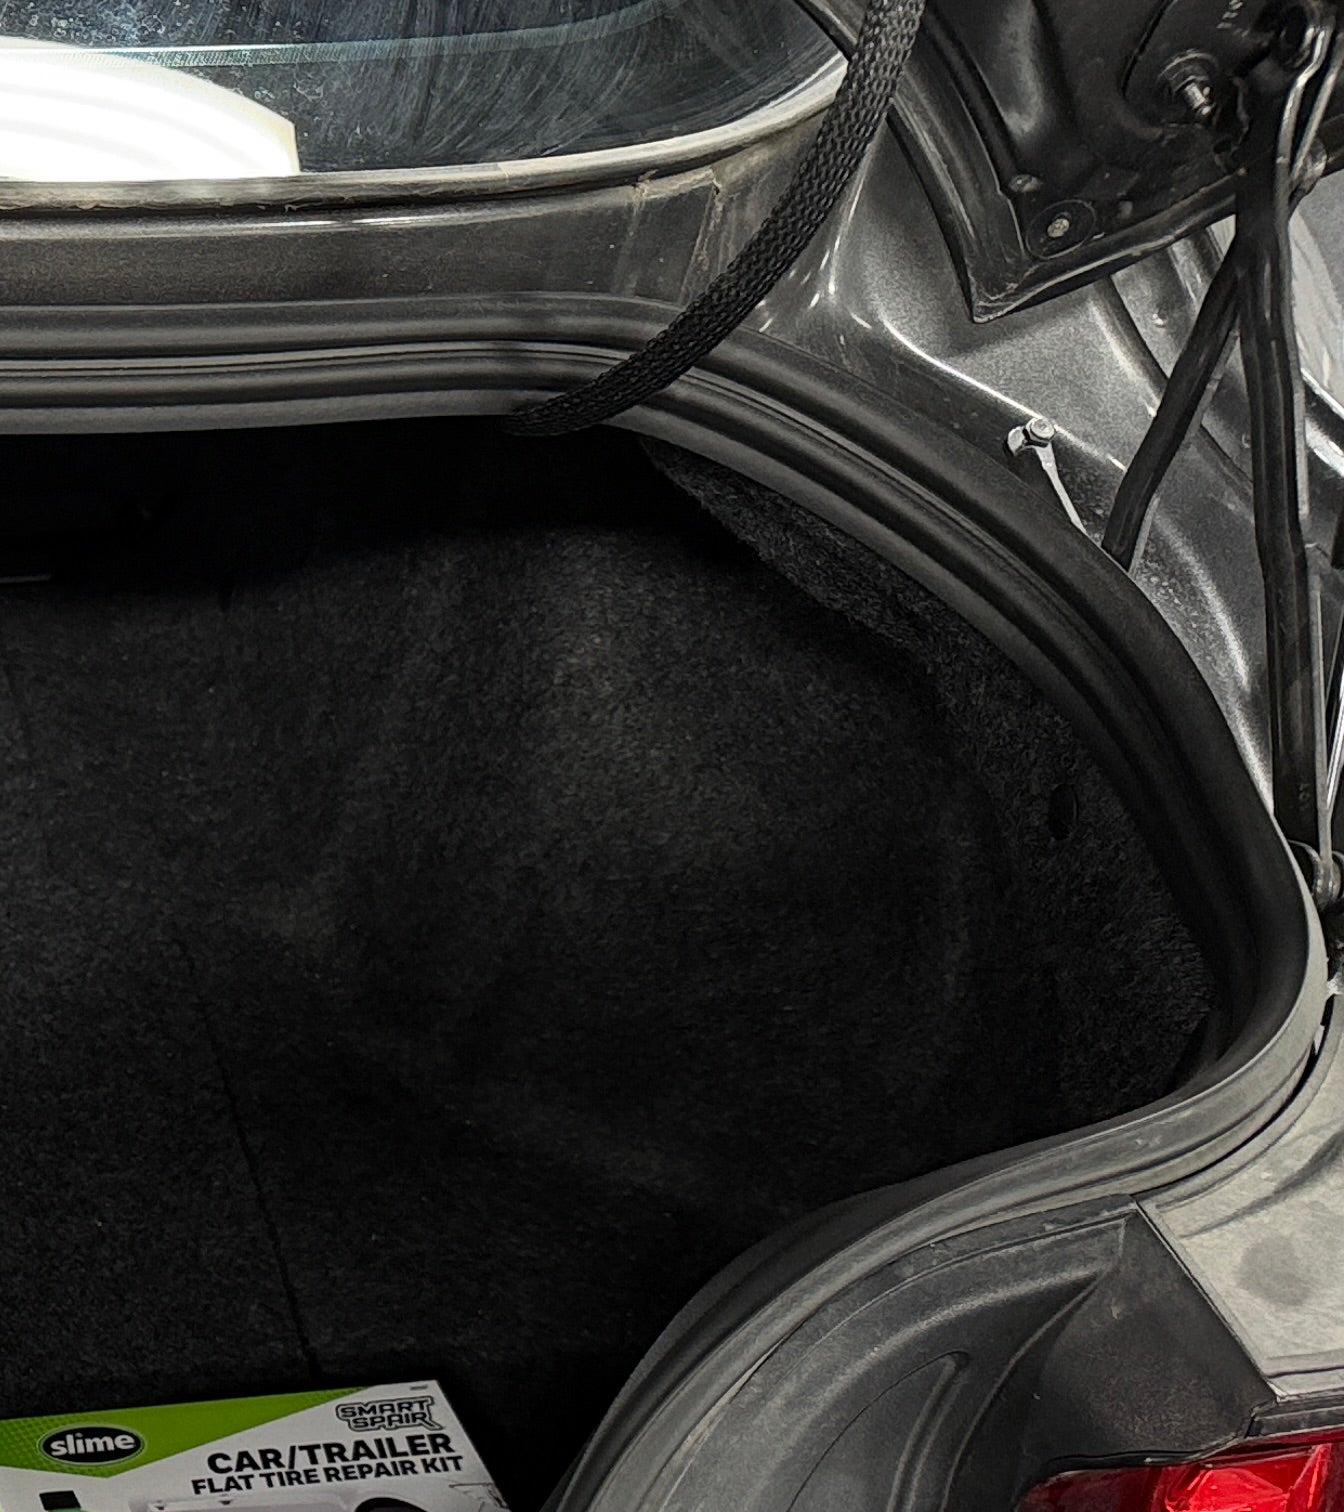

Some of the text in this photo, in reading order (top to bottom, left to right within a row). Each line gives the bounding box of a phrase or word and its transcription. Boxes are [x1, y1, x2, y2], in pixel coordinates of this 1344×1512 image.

[340, 1399, 430, 1418] SMART
[352, 1411, 432, 1429] SPAIR
[49, 1432, 137, 1457] slime
[206, 1432, 456, 1474] CAR/TRAILER
[191, 1455, 464, 1495] FLAT TIRE REPAIR KIT
